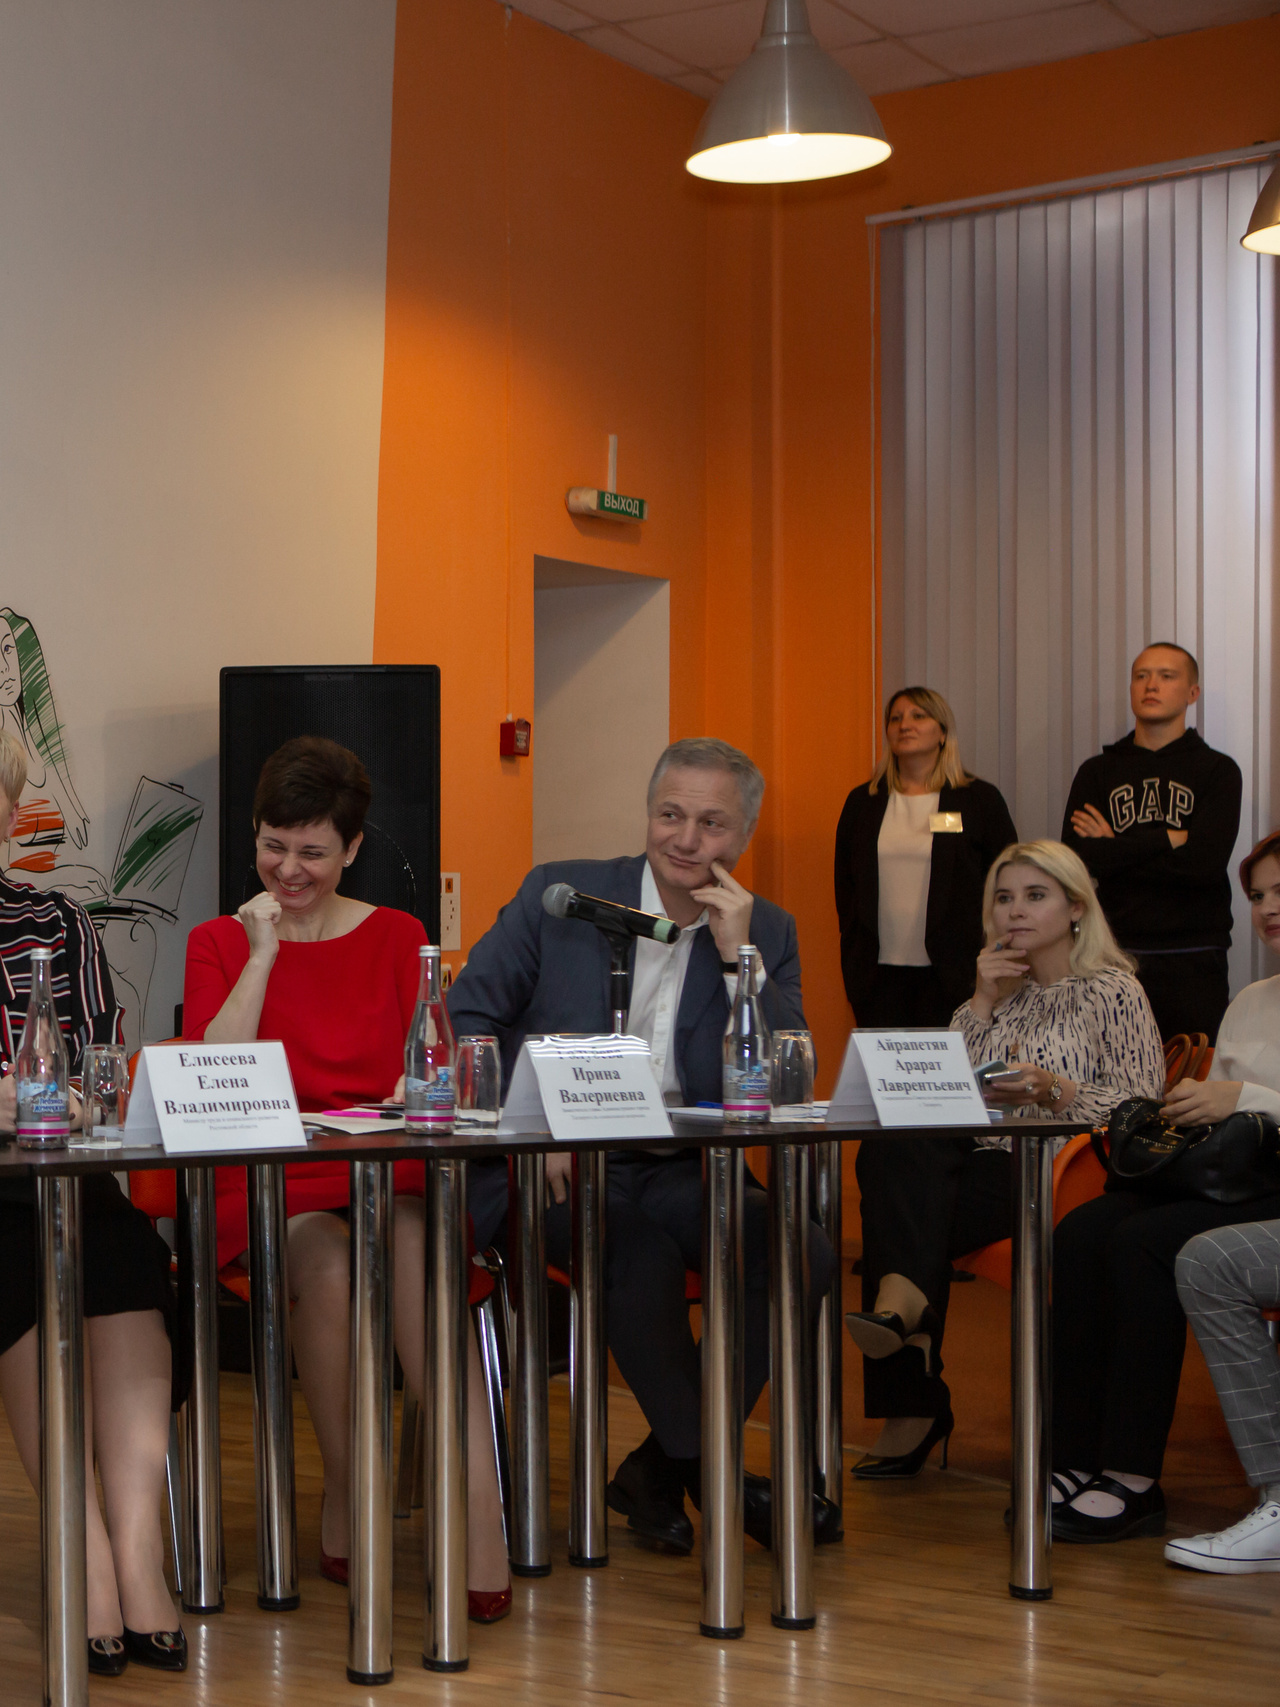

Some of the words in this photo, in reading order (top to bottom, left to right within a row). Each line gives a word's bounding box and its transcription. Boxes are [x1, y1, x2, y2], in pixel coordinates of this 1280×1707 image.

[604, 493, 640, 517] ВЫХОД
[1109, 777, 1195, 833] GAP
[876, 1038, 949, 1054] Айрапетян
[178, 1052, 257, 1068] Елисеева
[895, 1058, 943, 1074] Арарат
[197, 1074, 250, 1090] Елена
[571, 1066, 621, 1084] Ирина
[877, 1078, 972, 1095] Лаврентьевич
[164, 1097, 292, 1115] Владимировна
